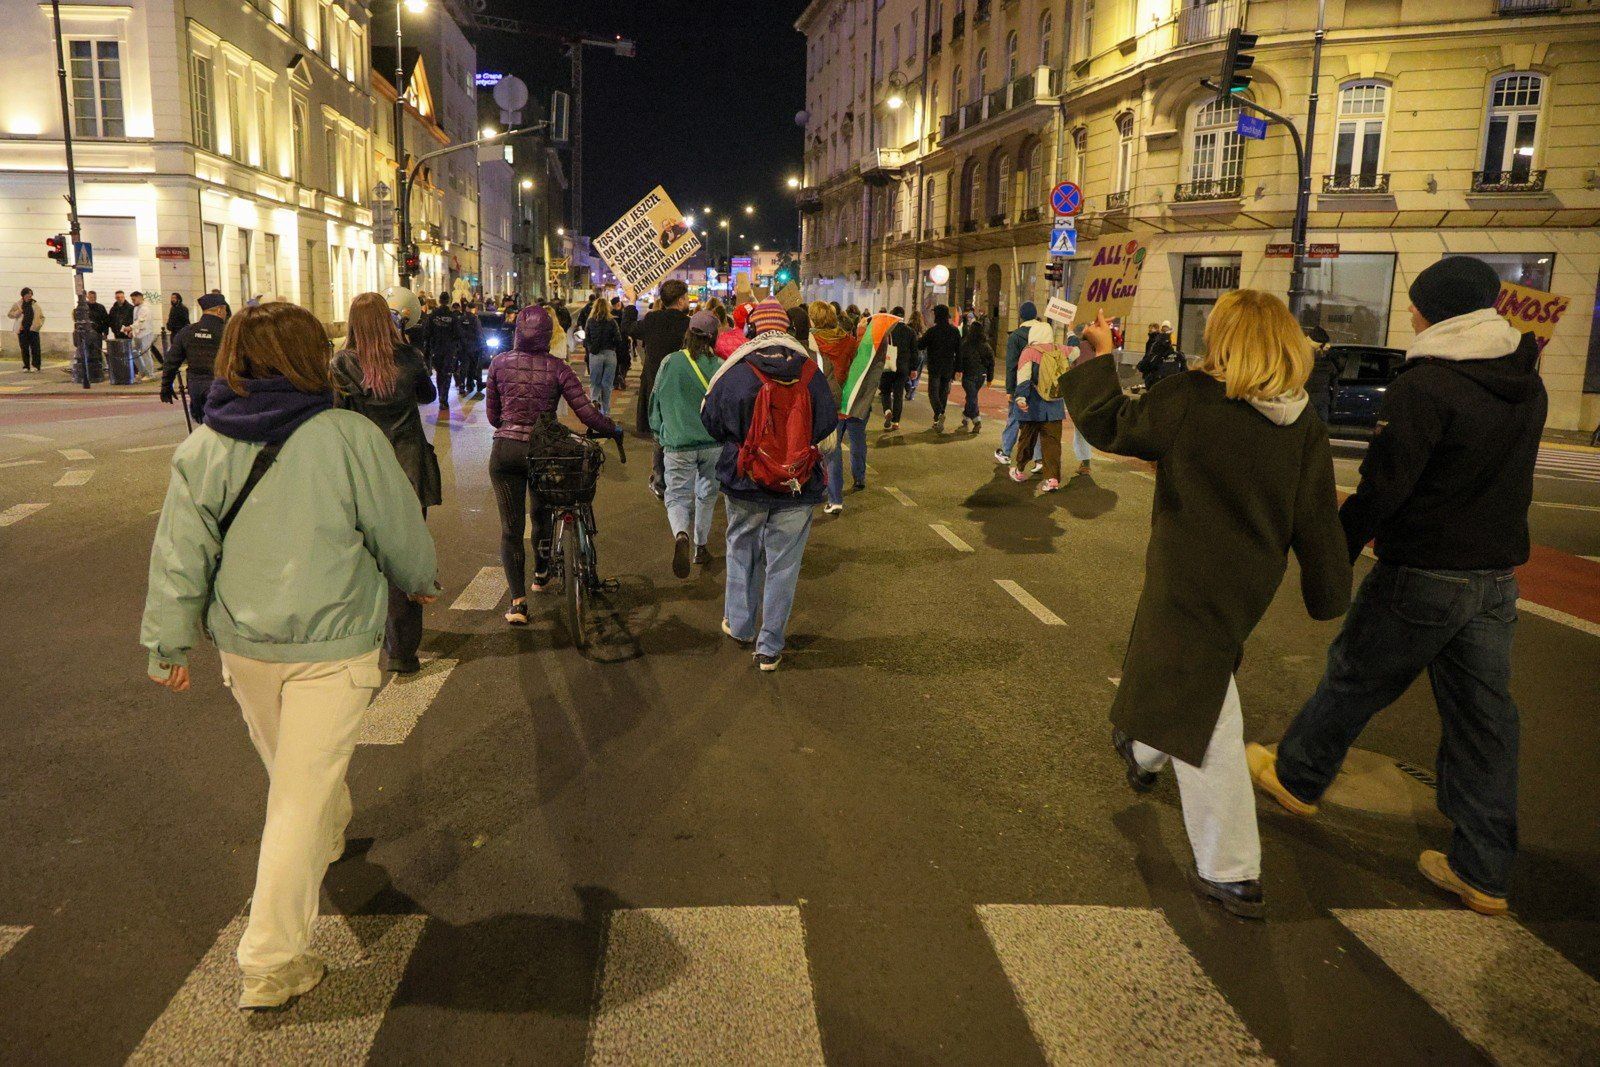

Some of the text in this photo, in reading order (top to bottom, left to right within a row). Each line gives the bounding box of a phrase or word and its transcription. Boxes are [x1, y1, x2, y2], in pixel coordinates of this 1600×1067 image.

[597, 193, 661, 248] ZOSTAŁY JESZCZE
[603, 217, 652, 259] DO WYBORU:
[614, 228, 658, 266] SPECJALNA
[620, 241, 659, 275] WOJENNA
[1093, 243, 1123, 266] ALL
[626, 249, 666, 284] OPERACJA
[633, 237, 700, 295] DEMILITARYZACJA
[1192, 266, 1241, 289] MANDE
[1086, 277, 1113, 303] ON
